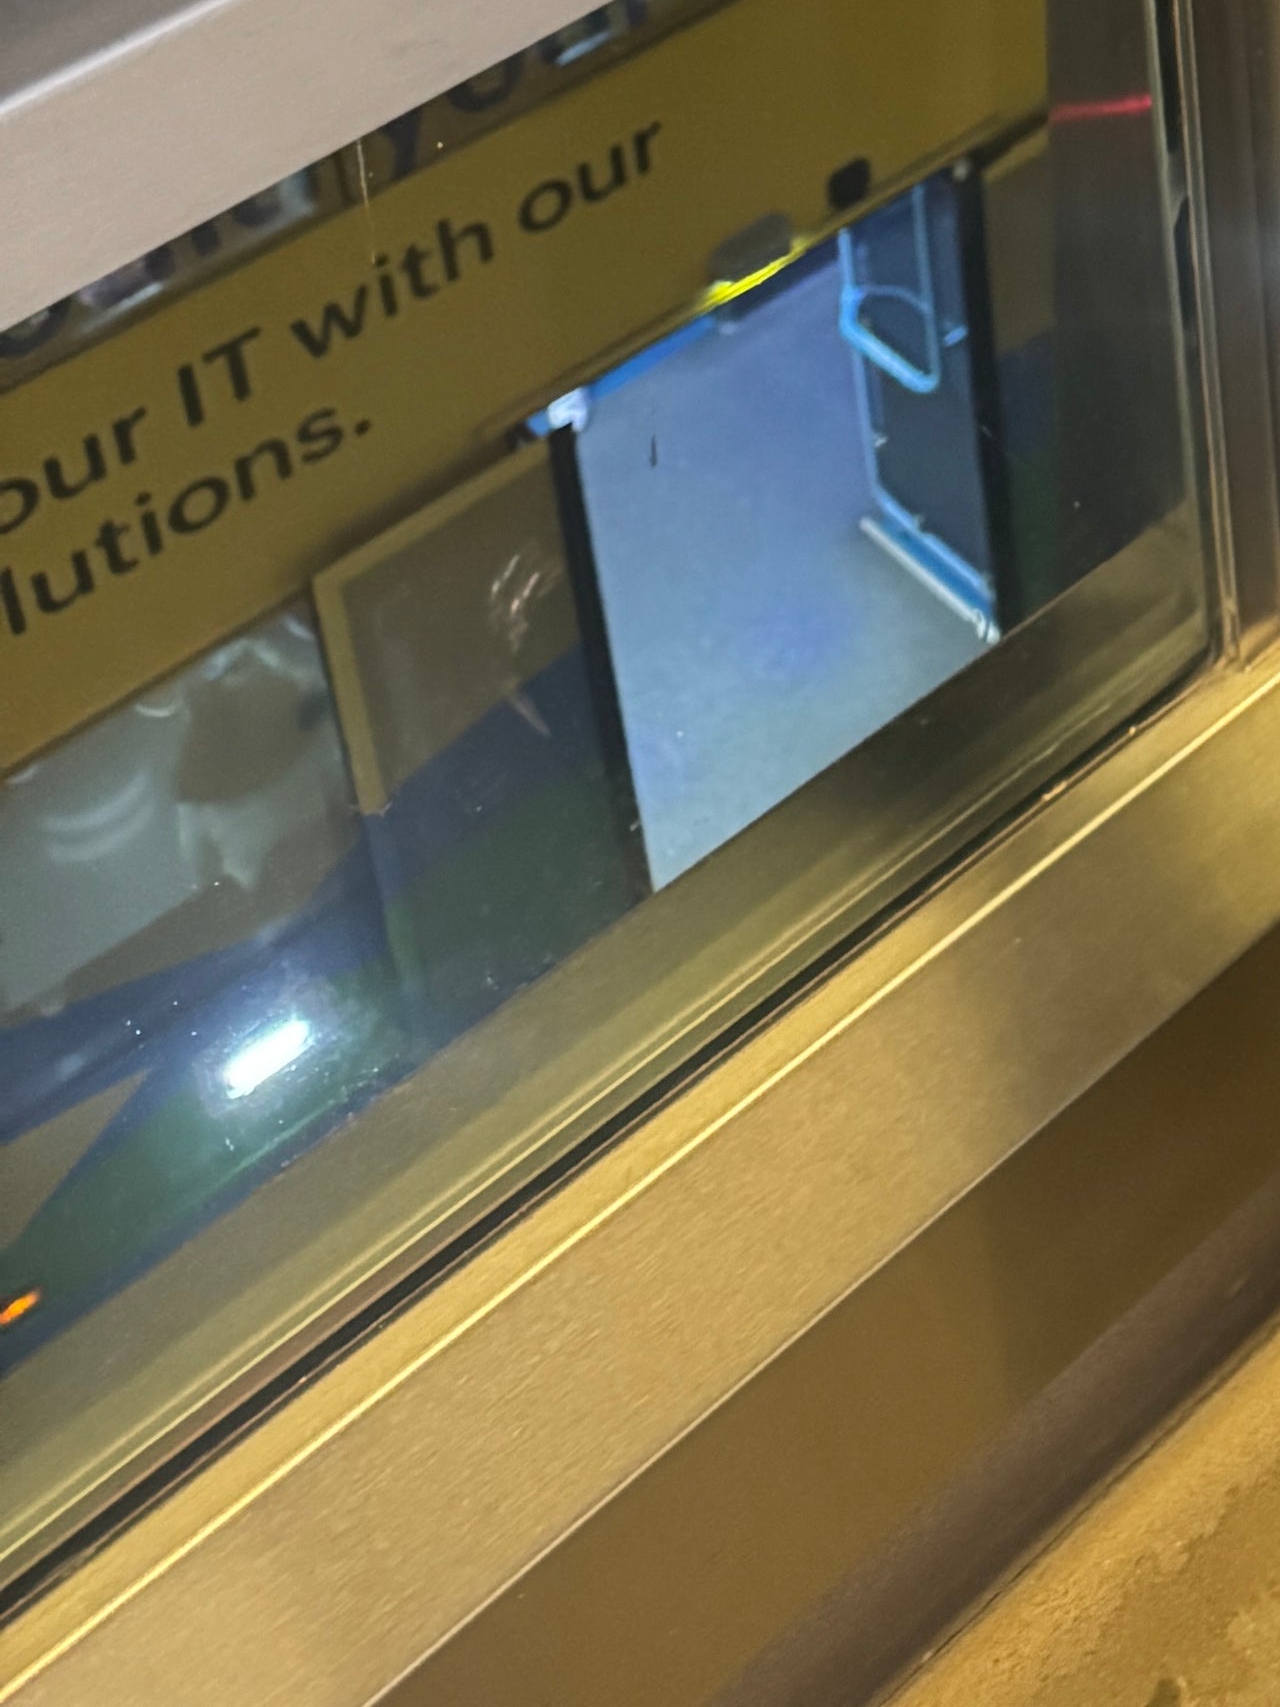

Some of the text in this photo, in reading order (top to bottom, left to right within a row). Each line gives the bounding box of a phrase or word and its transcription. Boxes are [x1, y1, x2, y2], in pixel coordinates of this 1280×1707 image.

[176, 326, 260, 429] IT
[290, 217, 496, 360] with
[517, 119, 662, 235] our
